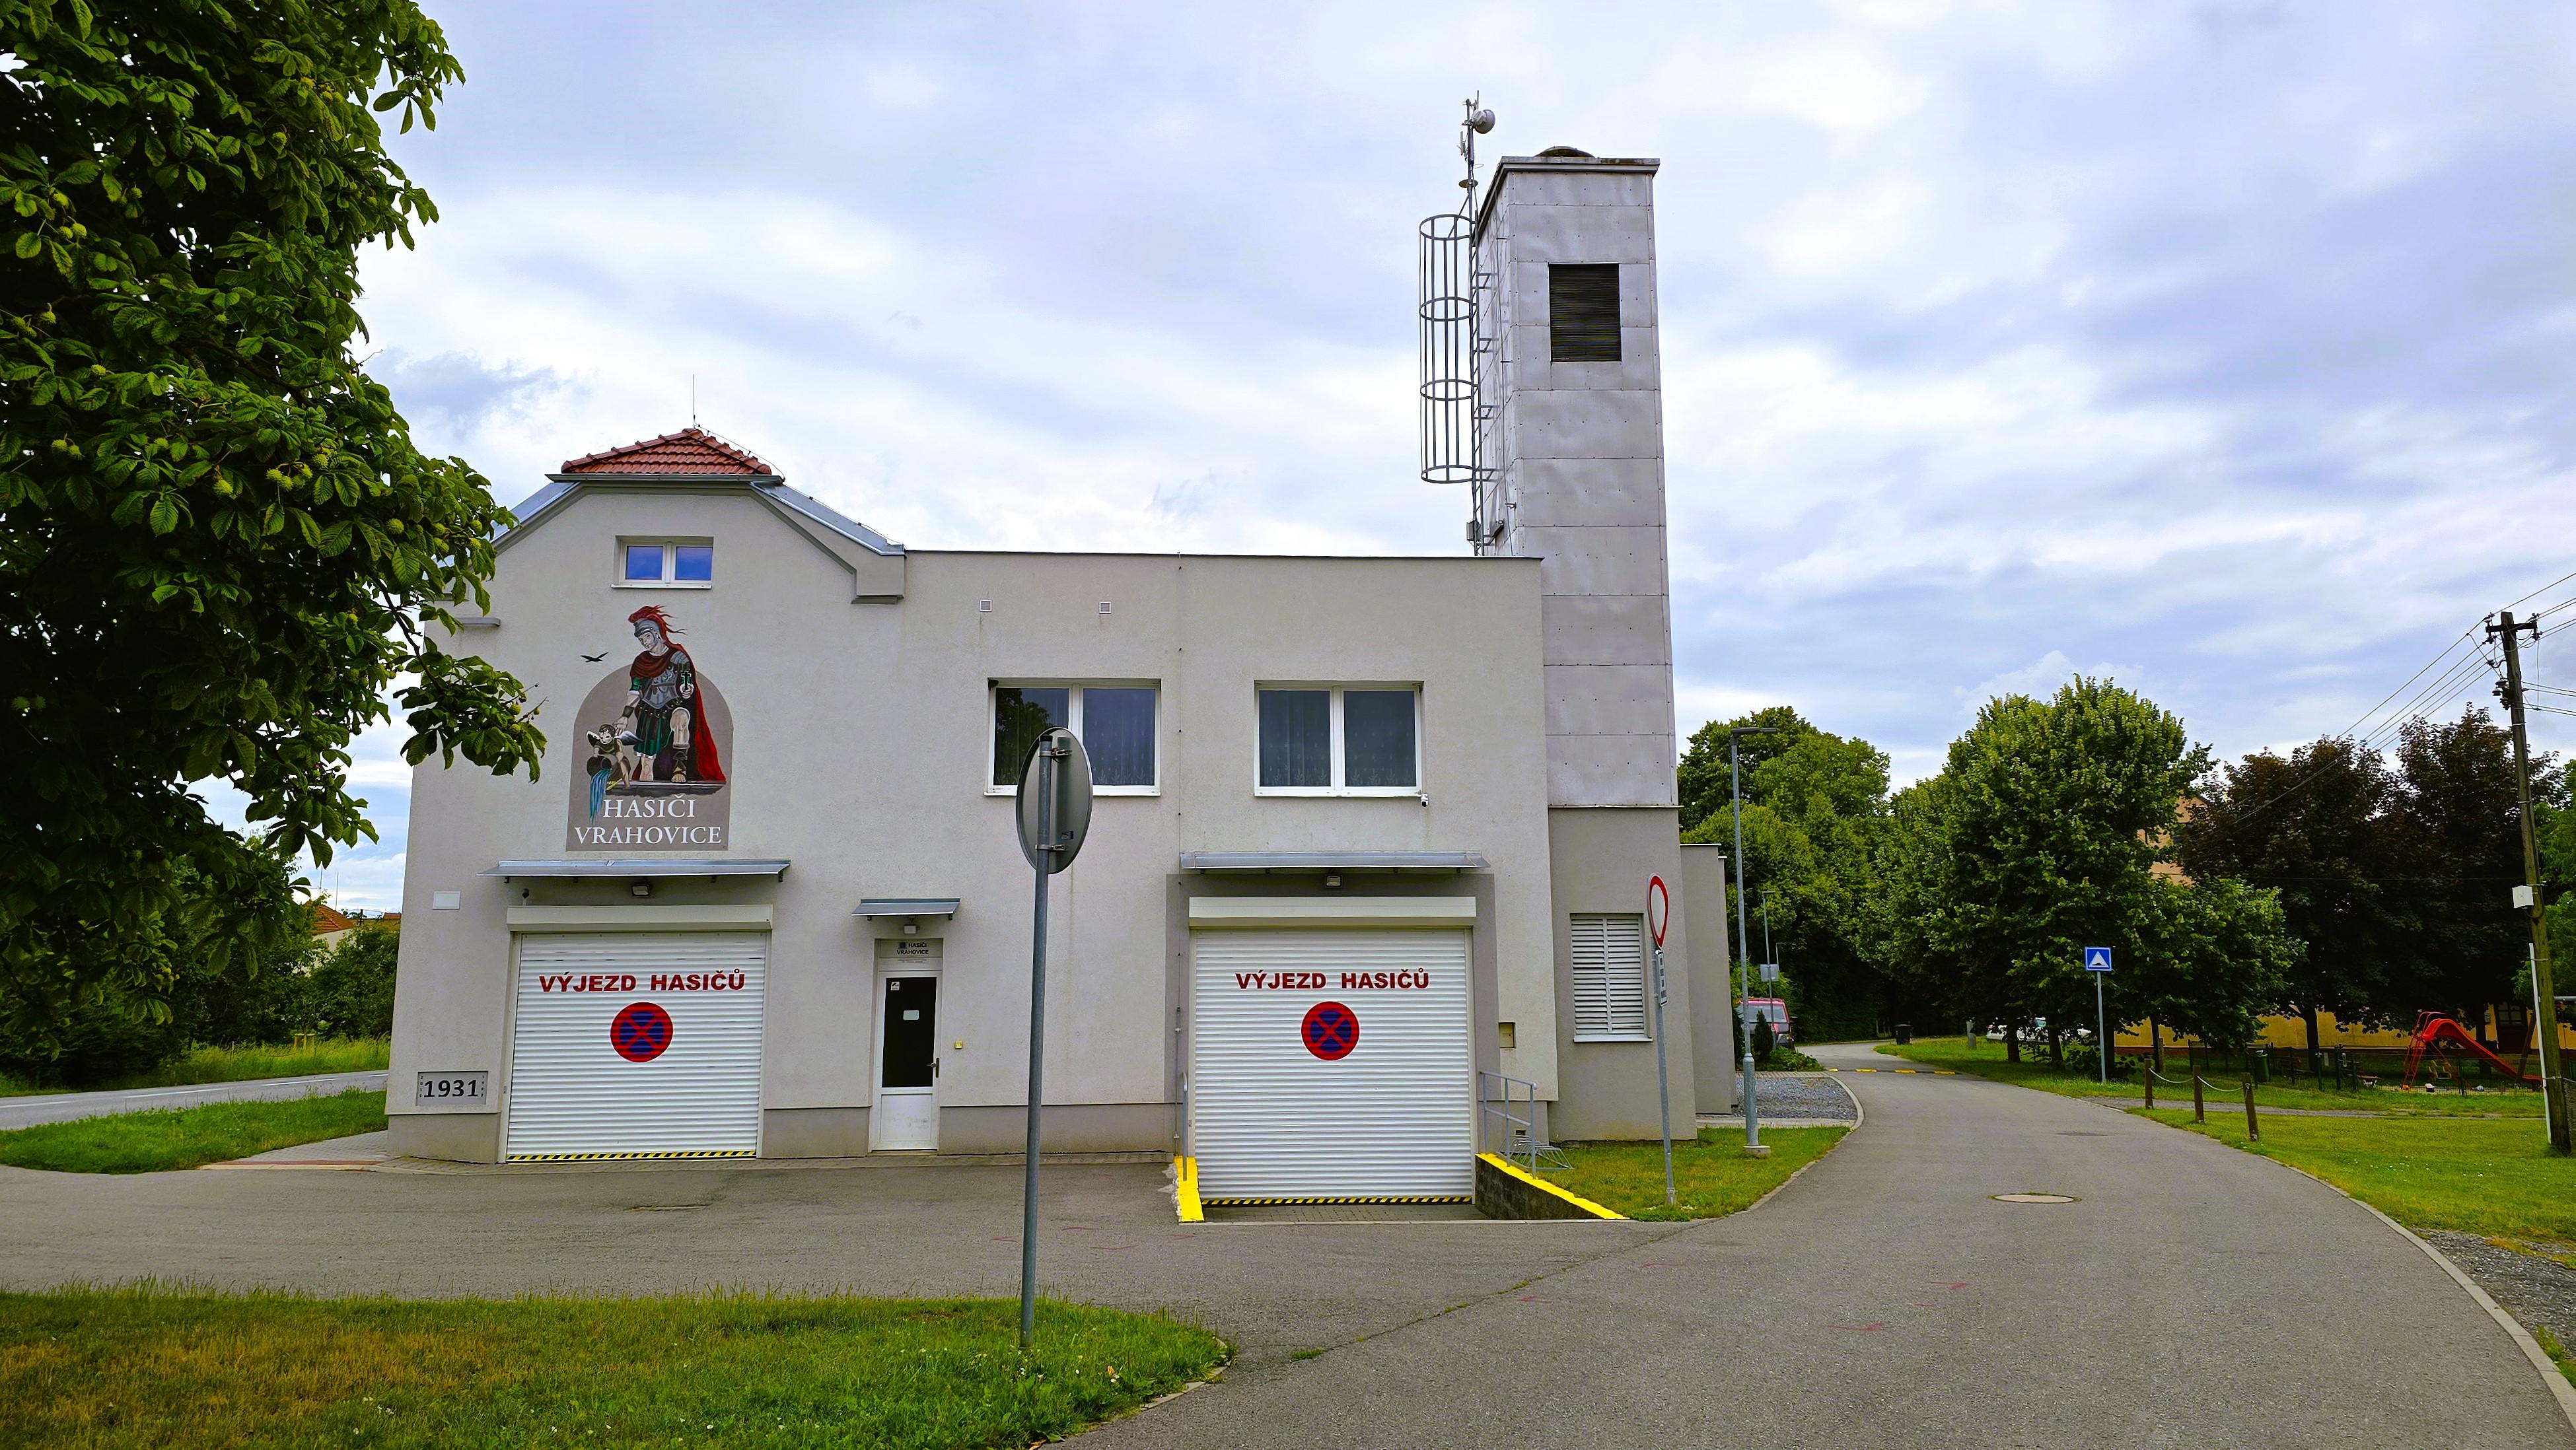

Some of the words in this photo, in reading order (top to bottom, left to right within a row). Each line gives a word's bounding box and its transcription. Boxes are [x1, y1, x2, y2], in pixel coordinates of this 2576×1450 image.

[602, 794, 696, 818] HASIČI
[574, 826, 722, 845] VRAHOVICE
[539, 971, 637, 992] VÝJEZD
[650, 968, 745, 990] HASIČŮ
[1235, 969, 1327, 989] VÝJEZD
[1341, 967, 1429, 989] HASIČŮ
[423, 1080, 478, 1097] 1931
